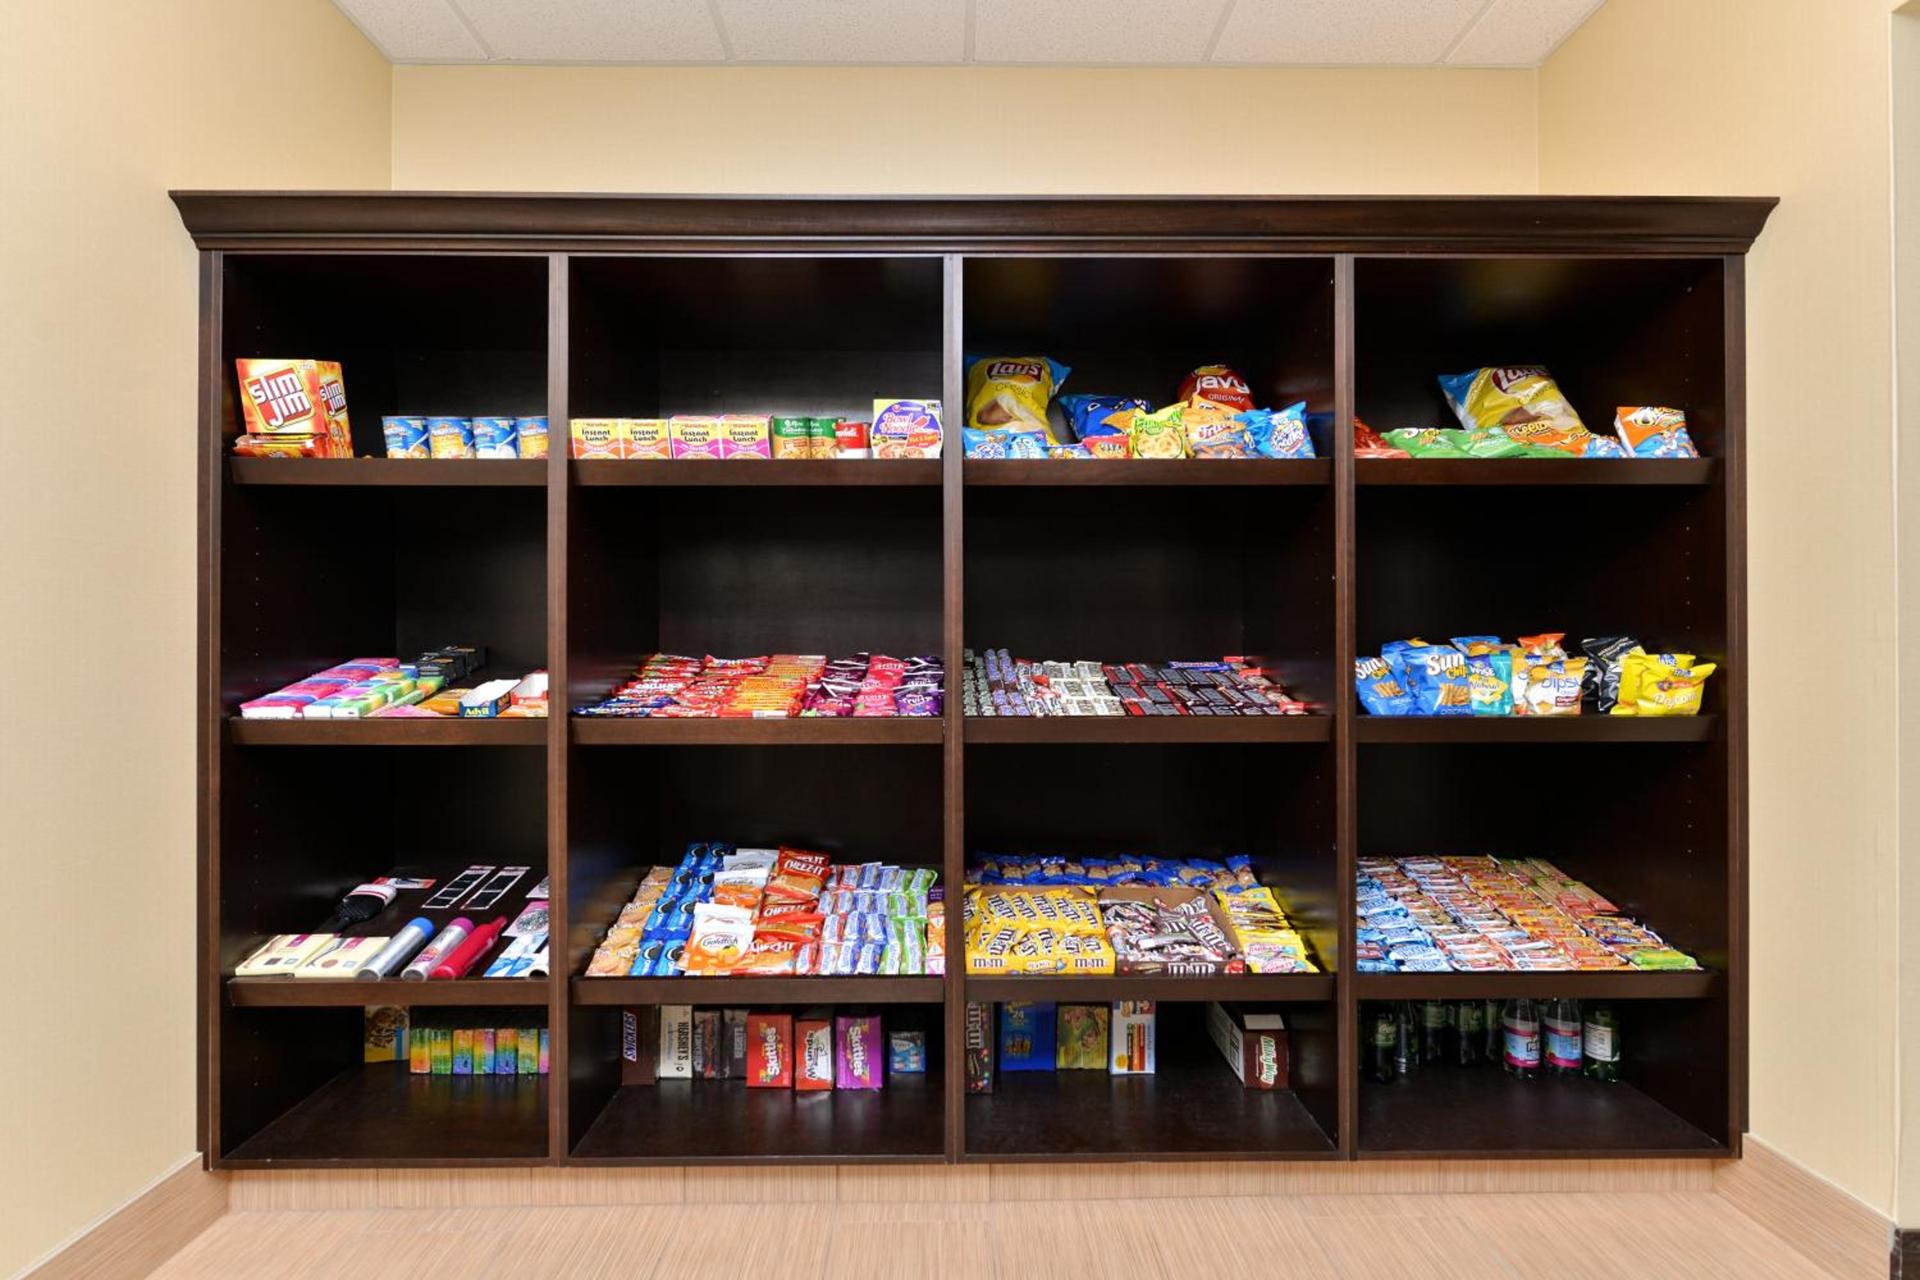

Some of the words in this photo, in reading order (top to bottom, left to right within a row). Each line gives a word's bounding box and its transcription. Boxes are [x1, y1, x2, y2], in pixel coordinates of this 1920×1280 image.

[1426, 653, 1465, 676] Sun
[466, 707, 490, 716] Advil
[766, 1027, 780, 1076] Skittles
